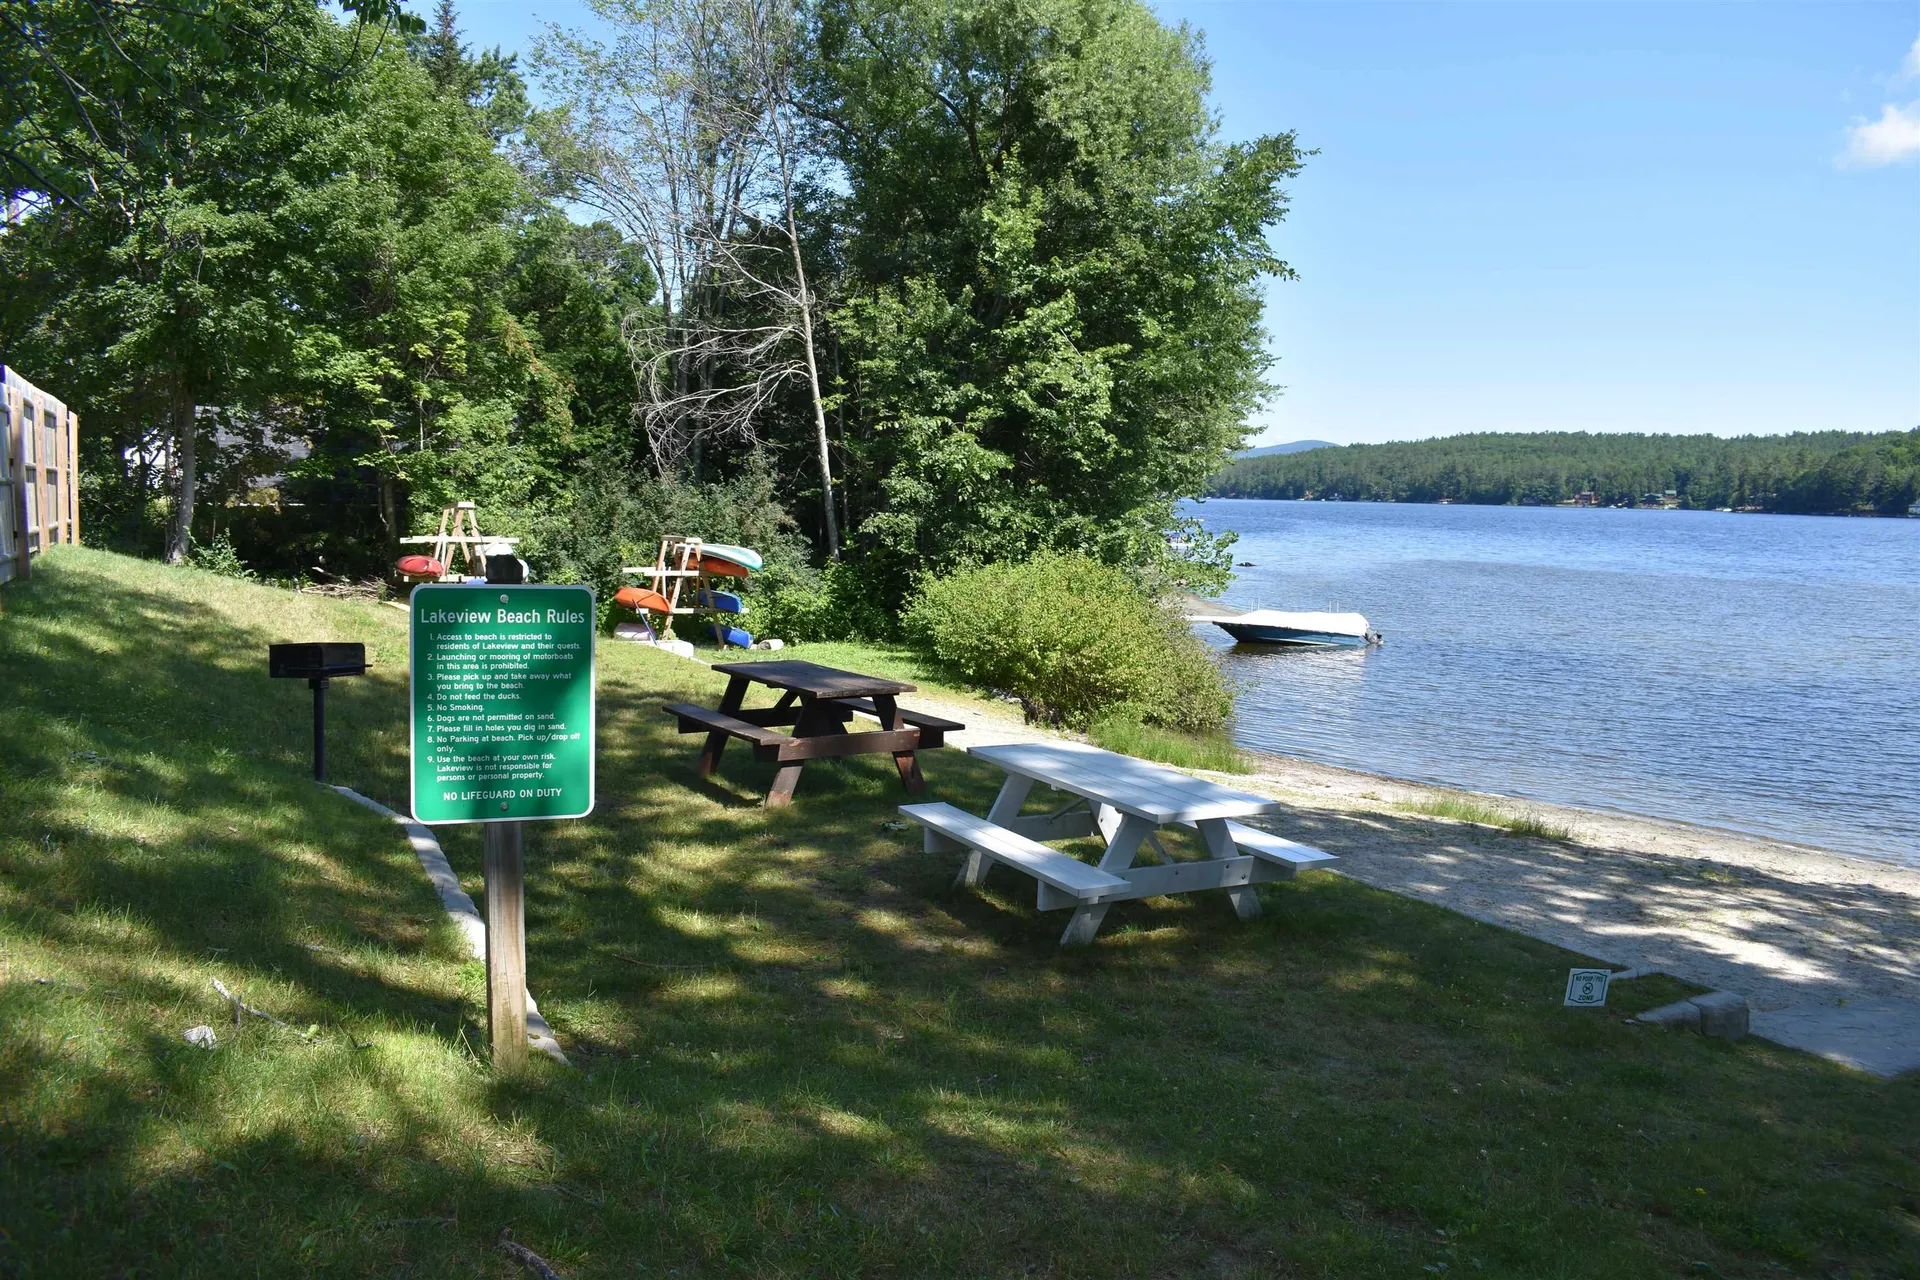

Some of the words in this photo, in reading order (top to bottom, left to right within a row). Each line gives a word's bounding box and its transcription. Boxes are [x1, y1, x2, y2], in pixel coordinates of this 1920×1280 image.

[421, 609, 491, 623] Lakeview
[497, 609, 540, 623] Beach
[547, 609, 585, 623] Rules
[437, 653, 476, 662] Launching
[490, 653, 520, 662] mooring
[490, 662, 529, 671] prohibited.
[463, 673, 479, 681] pick
[454, 683, 474, 691] bring
[450, 704, 485, 712] Smoking.
[487, 714, 522, 722] permitted
[524, 724, 536, 732] dig
[450, 735, 479, 744] Parking
[537, 733, 568, 742] up/drop
[437, 745, 455, 753] only.
[499, 762, 540, 771] responsible
[437, 774, 465, 782] persons
[478, 772, 509, 782] personal
[512, 772, 544, 781] property.
[443, 792, 457, 801] NO
[461, 790, 516, 800] LIFEGUARD
[537, 788, 562, 797] DUTY
